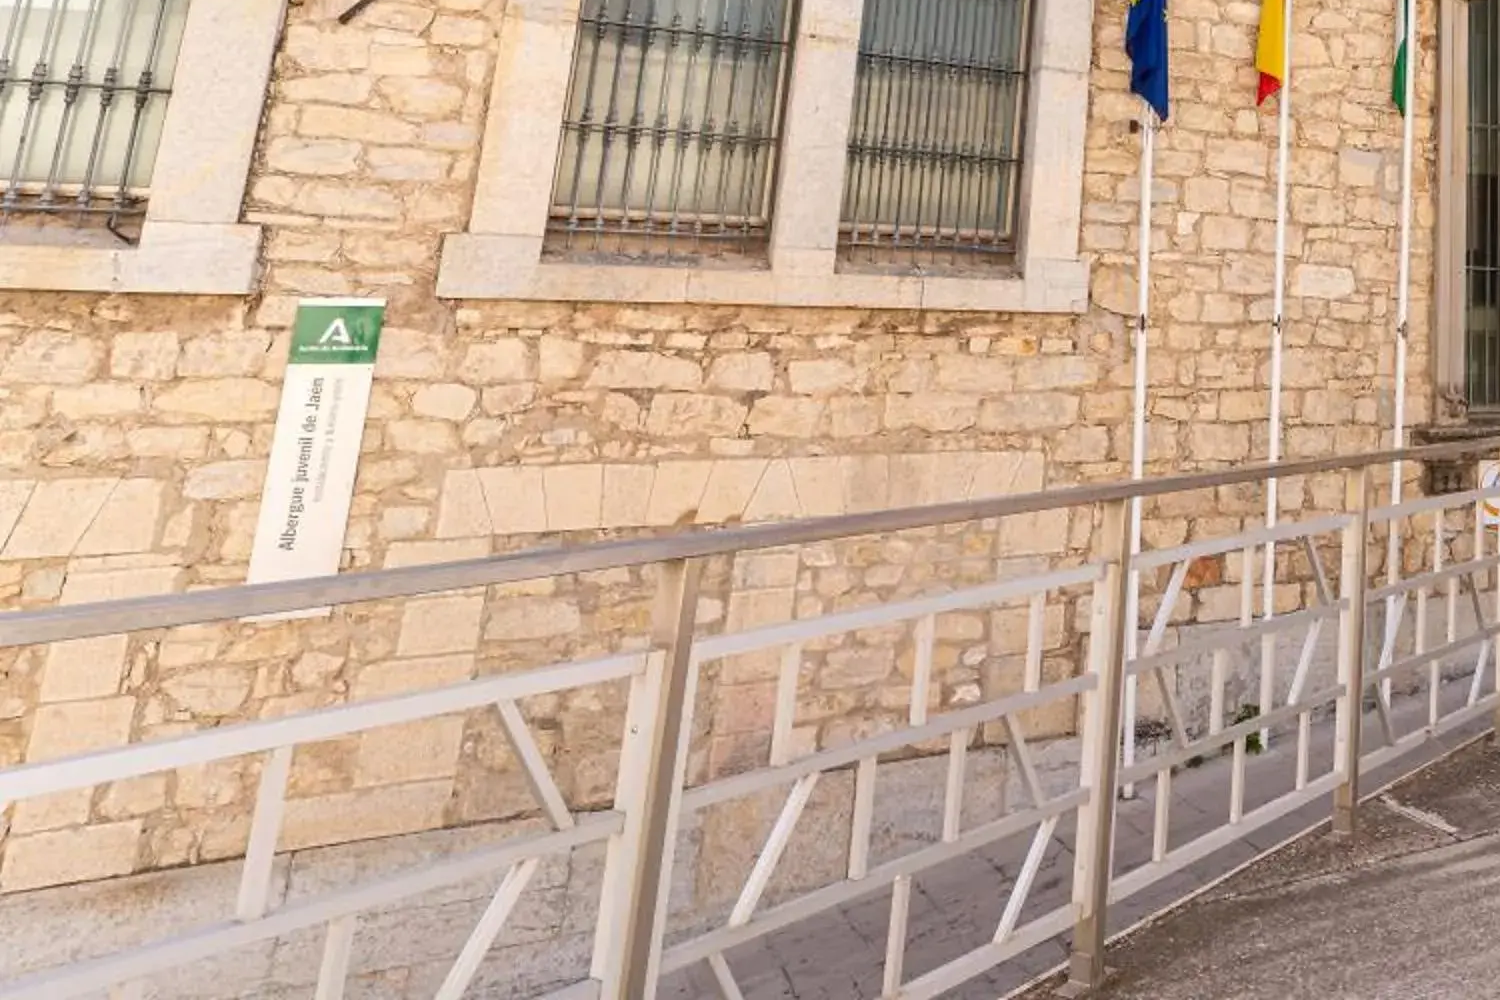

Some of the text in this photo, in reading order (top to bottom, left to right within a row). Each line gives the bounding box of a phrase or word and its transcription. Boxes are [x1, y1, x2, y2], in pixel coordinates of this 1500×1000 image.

[278, 377, 325, 551] Albergue juvenil de Jaén
